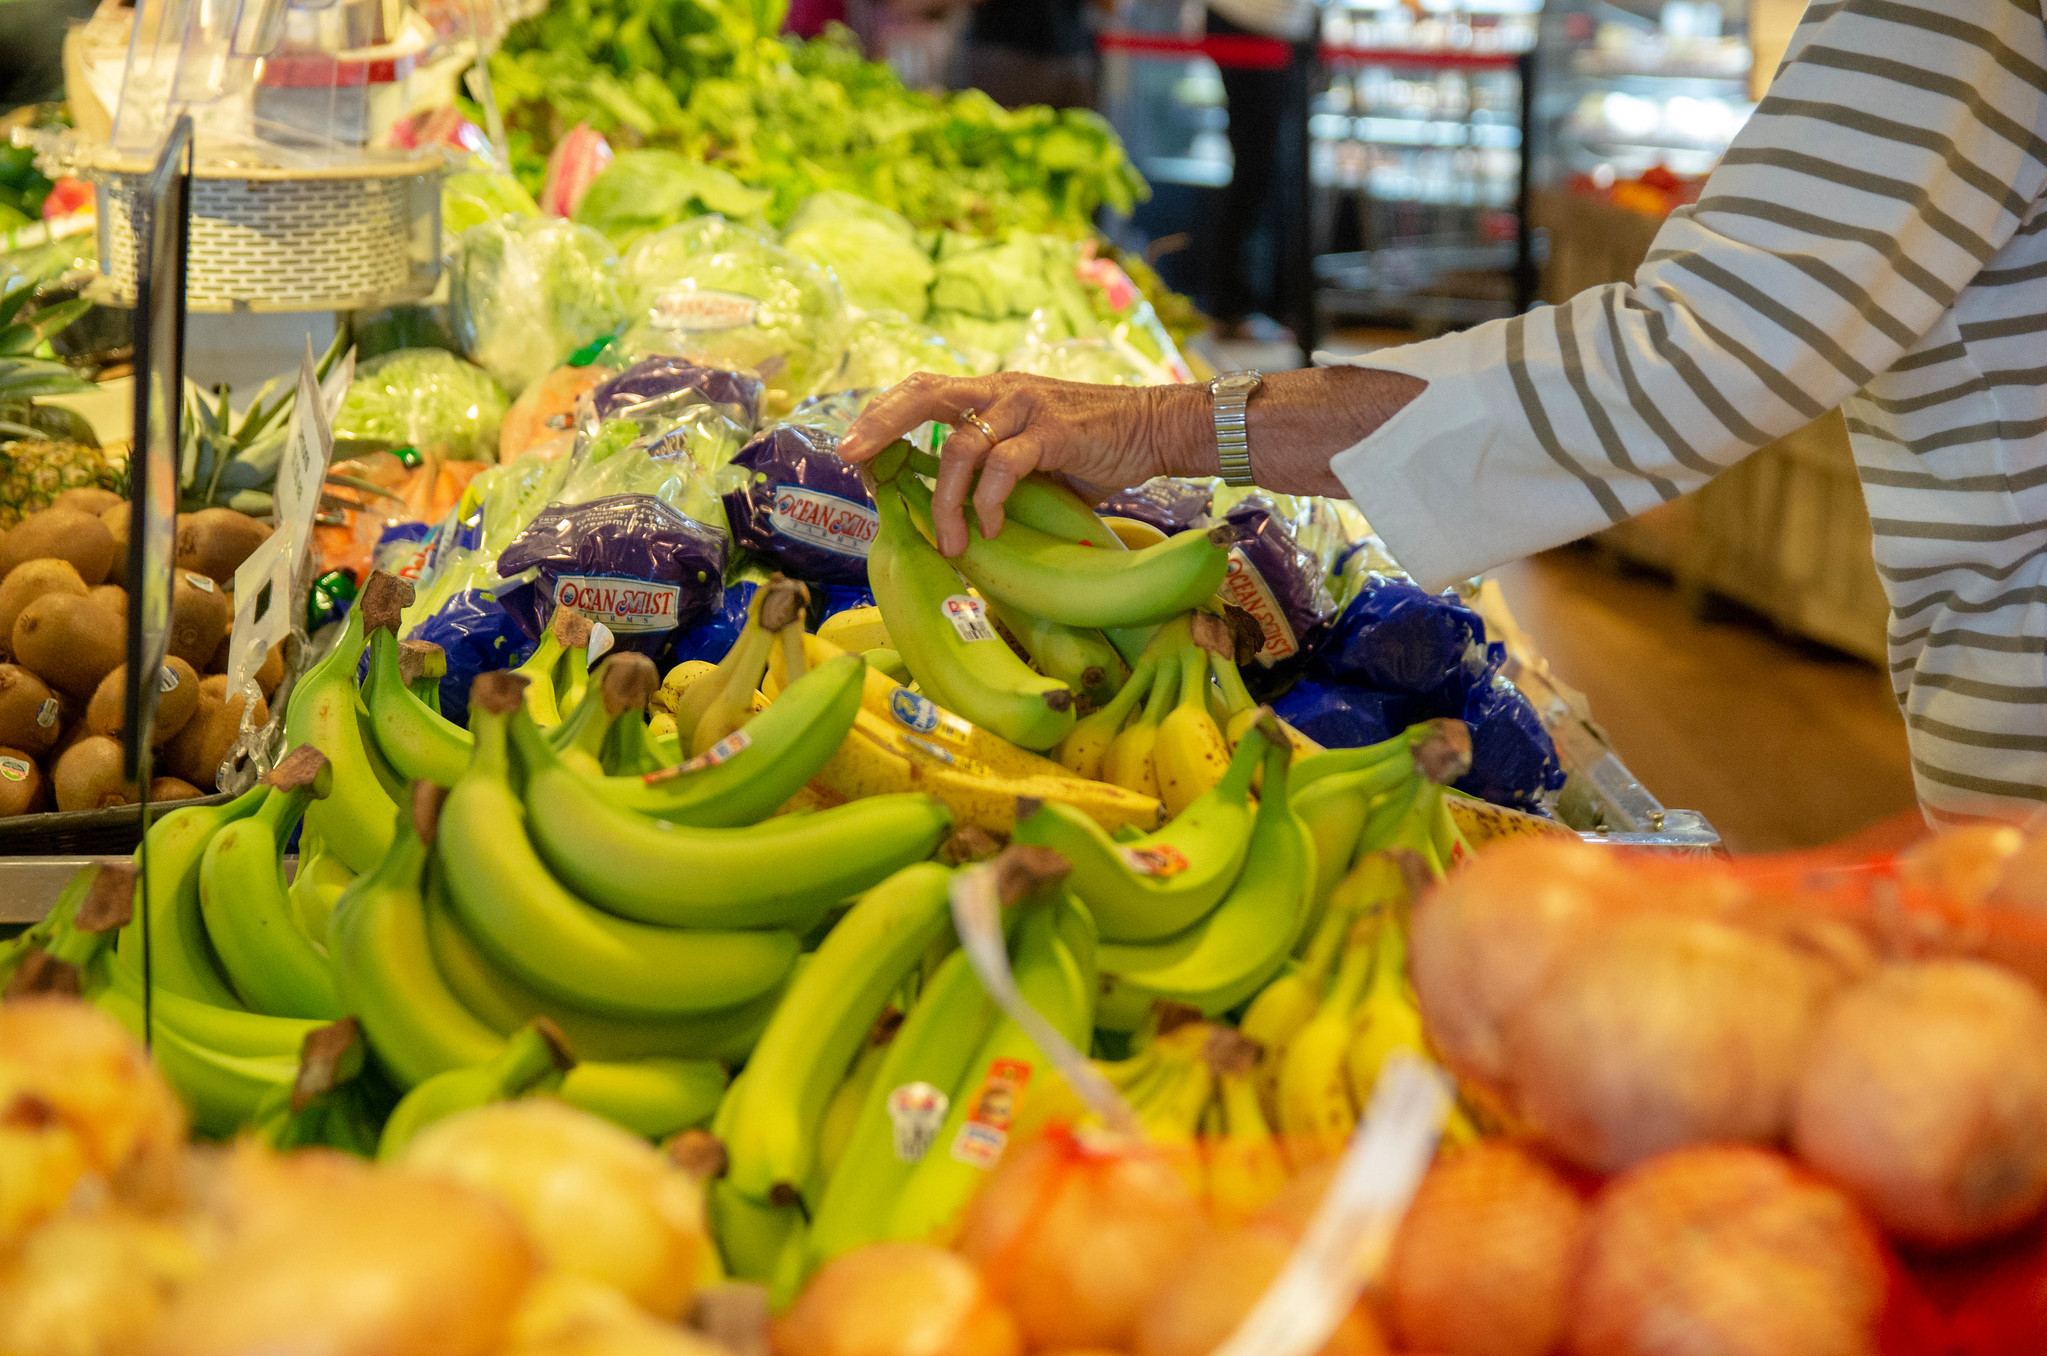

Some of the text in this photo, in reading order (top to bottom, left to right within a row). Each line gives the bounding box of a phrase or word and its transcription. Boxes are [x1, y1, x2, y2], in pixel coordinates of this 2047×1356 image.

[777, 493, 836, 528] OCEAN
[559, 582, 674, 617] OCEAN MIST
[1225, 558, 1267, 613] OCEAN
[947, 599, 979, 613] De
